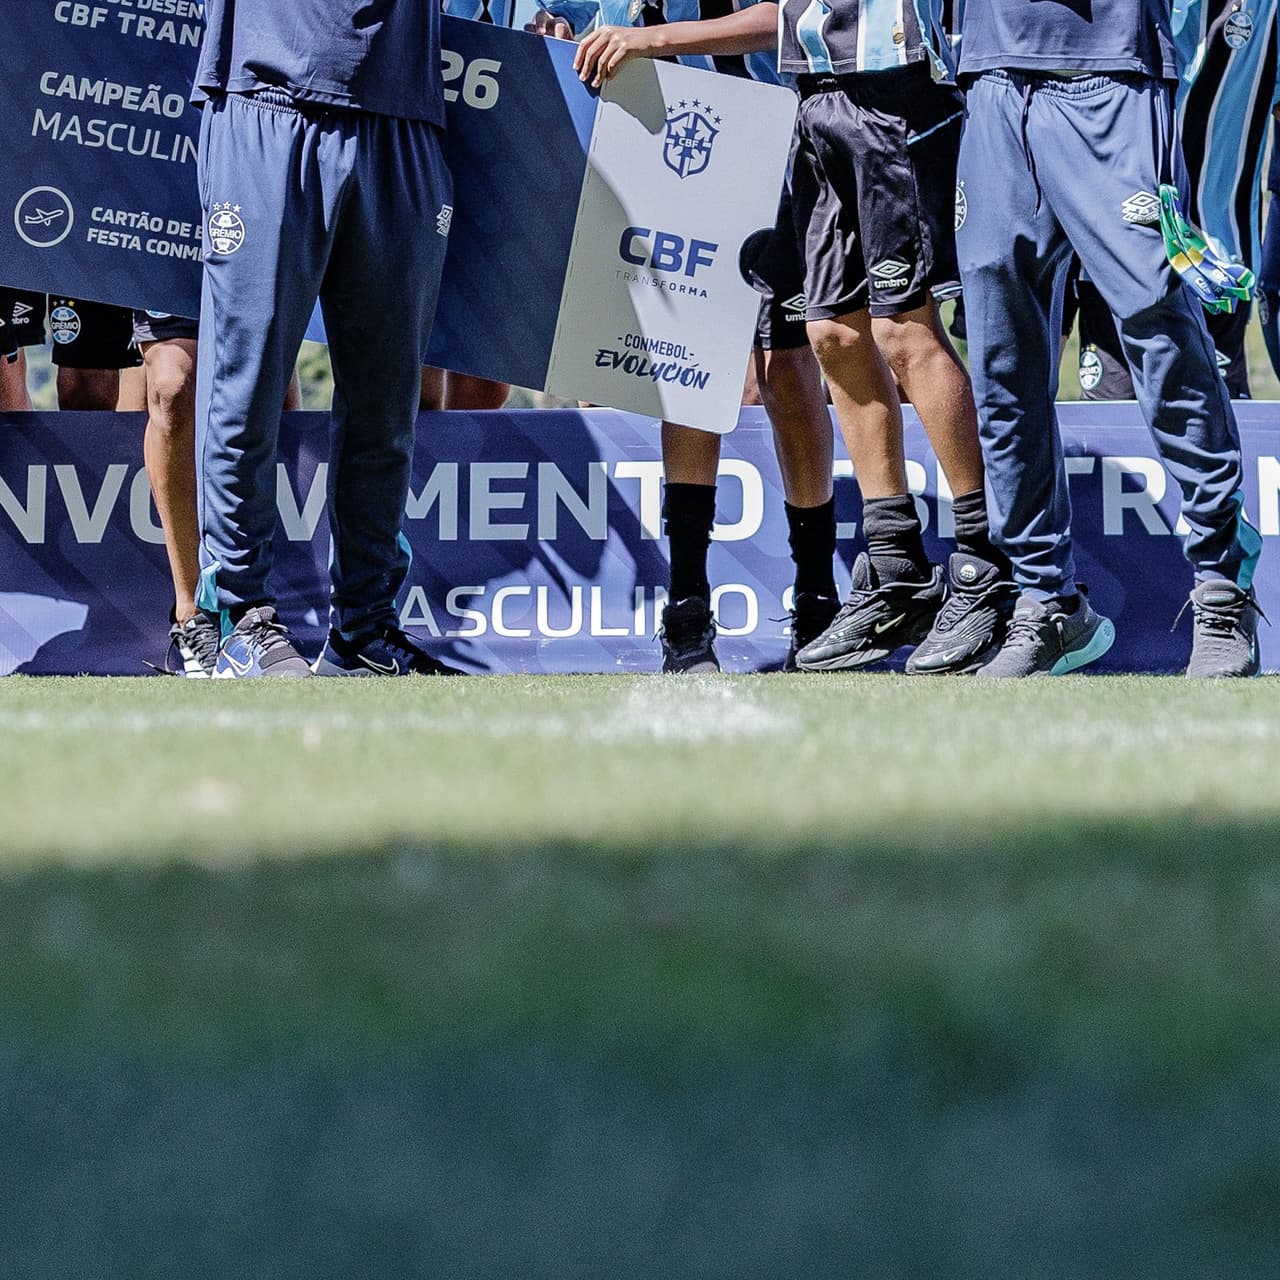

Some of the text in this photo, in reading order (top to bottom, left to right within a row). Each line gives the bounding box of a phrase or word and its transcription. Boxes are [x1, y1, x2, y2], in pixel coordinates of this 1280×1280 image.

[54, 1, 202, 48] CBF TRAN
[39, 71, 185, 119] CAMPEÃO
[440, 49, 502, 110] 26
[31, 108, 199, 164] MASCULIN
[679, 138, 699, 149] CBF
[86, 227, 142, 251] FESTA
[91, 206, 163, 233] CARTÃO
[167, 220, 192, 238] DE
[619, 226, 719, 278] CBF
[615, 269, 709, 299] TRANSFORMA
[873, 278, 909, 290] umbro
